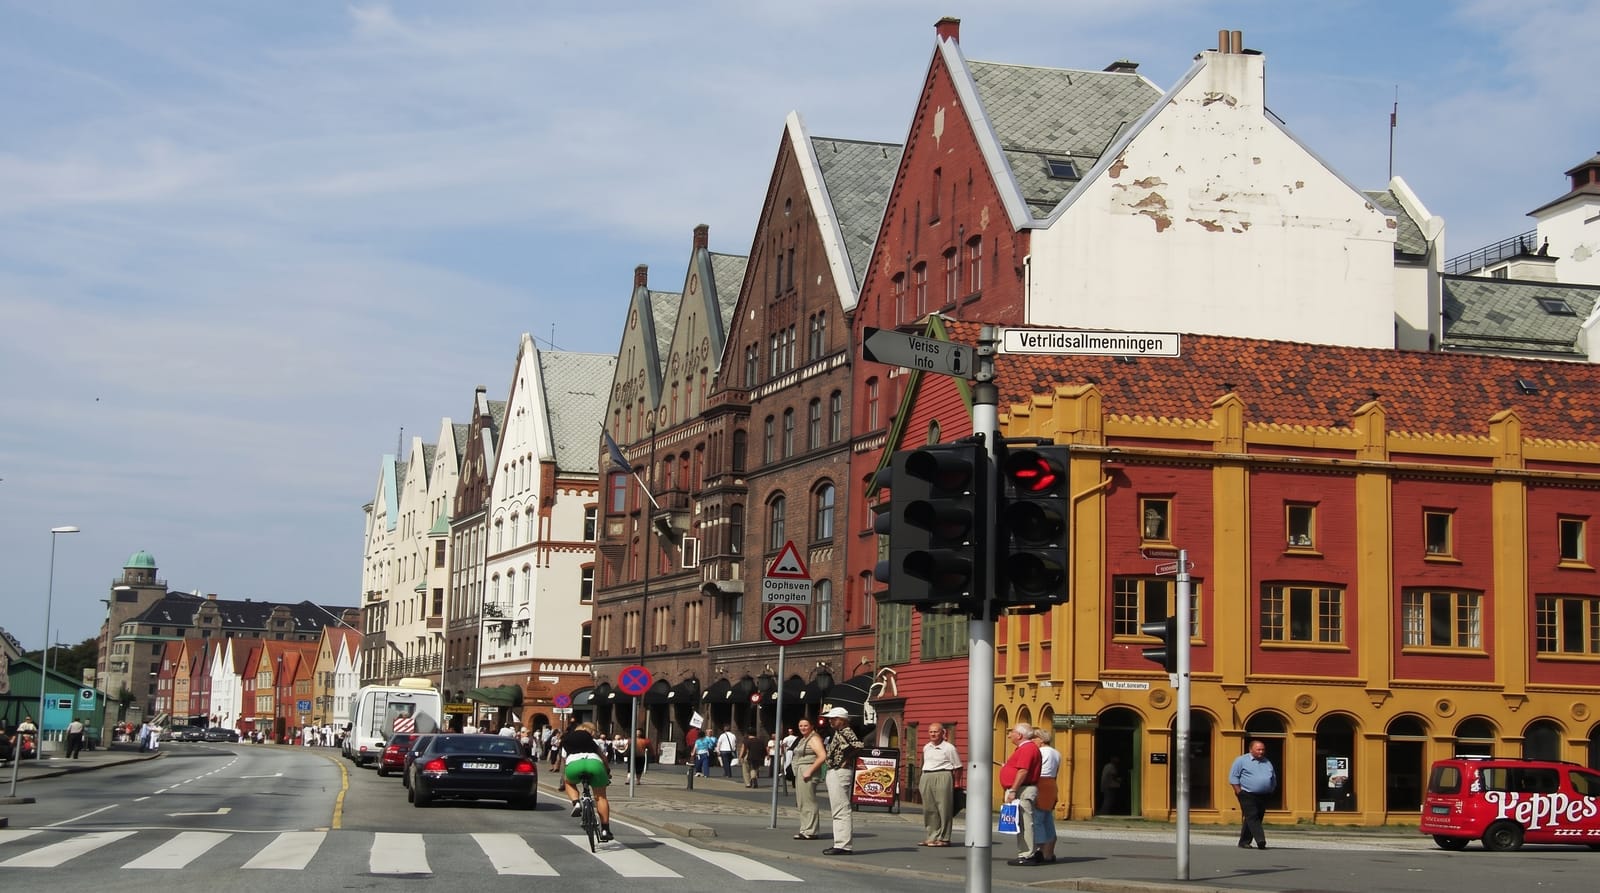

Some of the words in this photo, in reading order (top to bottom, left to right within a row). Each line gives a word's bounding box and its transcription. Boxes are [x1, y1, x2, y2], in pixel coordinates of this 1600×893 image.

[1019, 332, 1163, 353] Vetrlidsallmenningen
[772, 616, 800, 635] 30
[1485, 790, 1598, 831] Peppes
